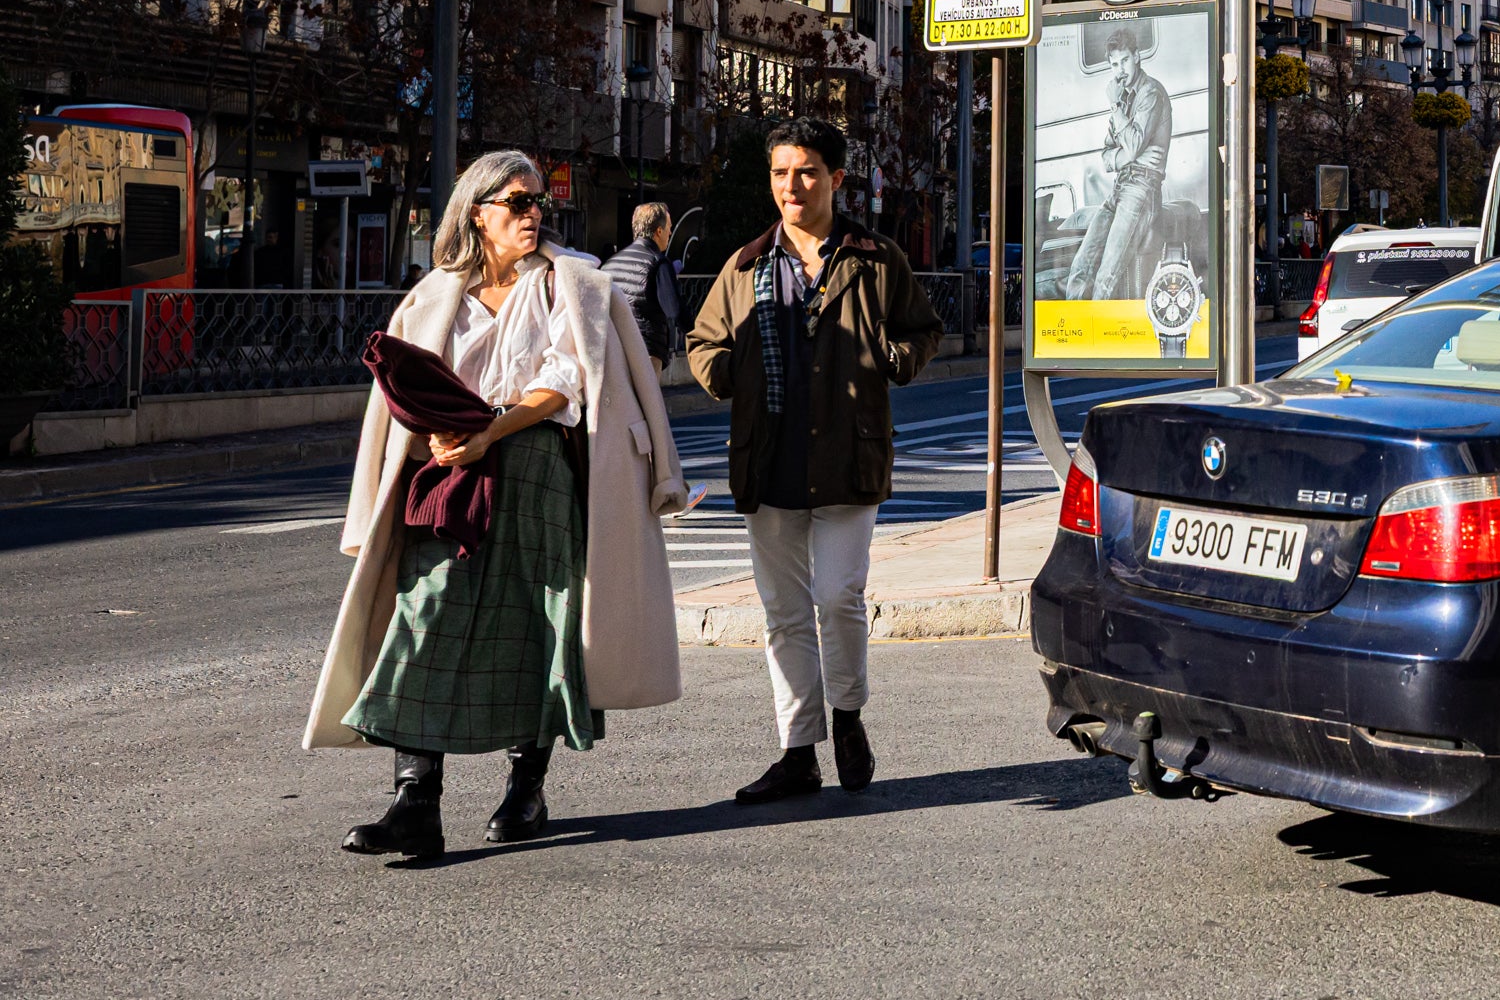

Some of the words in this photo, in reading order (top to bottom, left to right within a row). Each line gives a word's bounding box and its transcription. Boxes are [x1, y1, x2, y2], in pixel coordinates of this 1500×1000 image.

[940, 8, 974, 21] VEHÍCULOS
[977, 6, 1020, 18] AUTORIZADOS
[1099, 10, 1139, 21] JCDecaux
[934, 24, 946, 39] DE
[950, 22, 972, 39] 7:30
[975, 22, 980, 37] A
[984, 20, 1012, 36] 22:00
[1041, 329, 1083, 337] BREITLING
[1154, 537, 1163, 549] E
[1171, 517, 1234, 561] 9300
[1243, 526, 1298, 571] FFM
